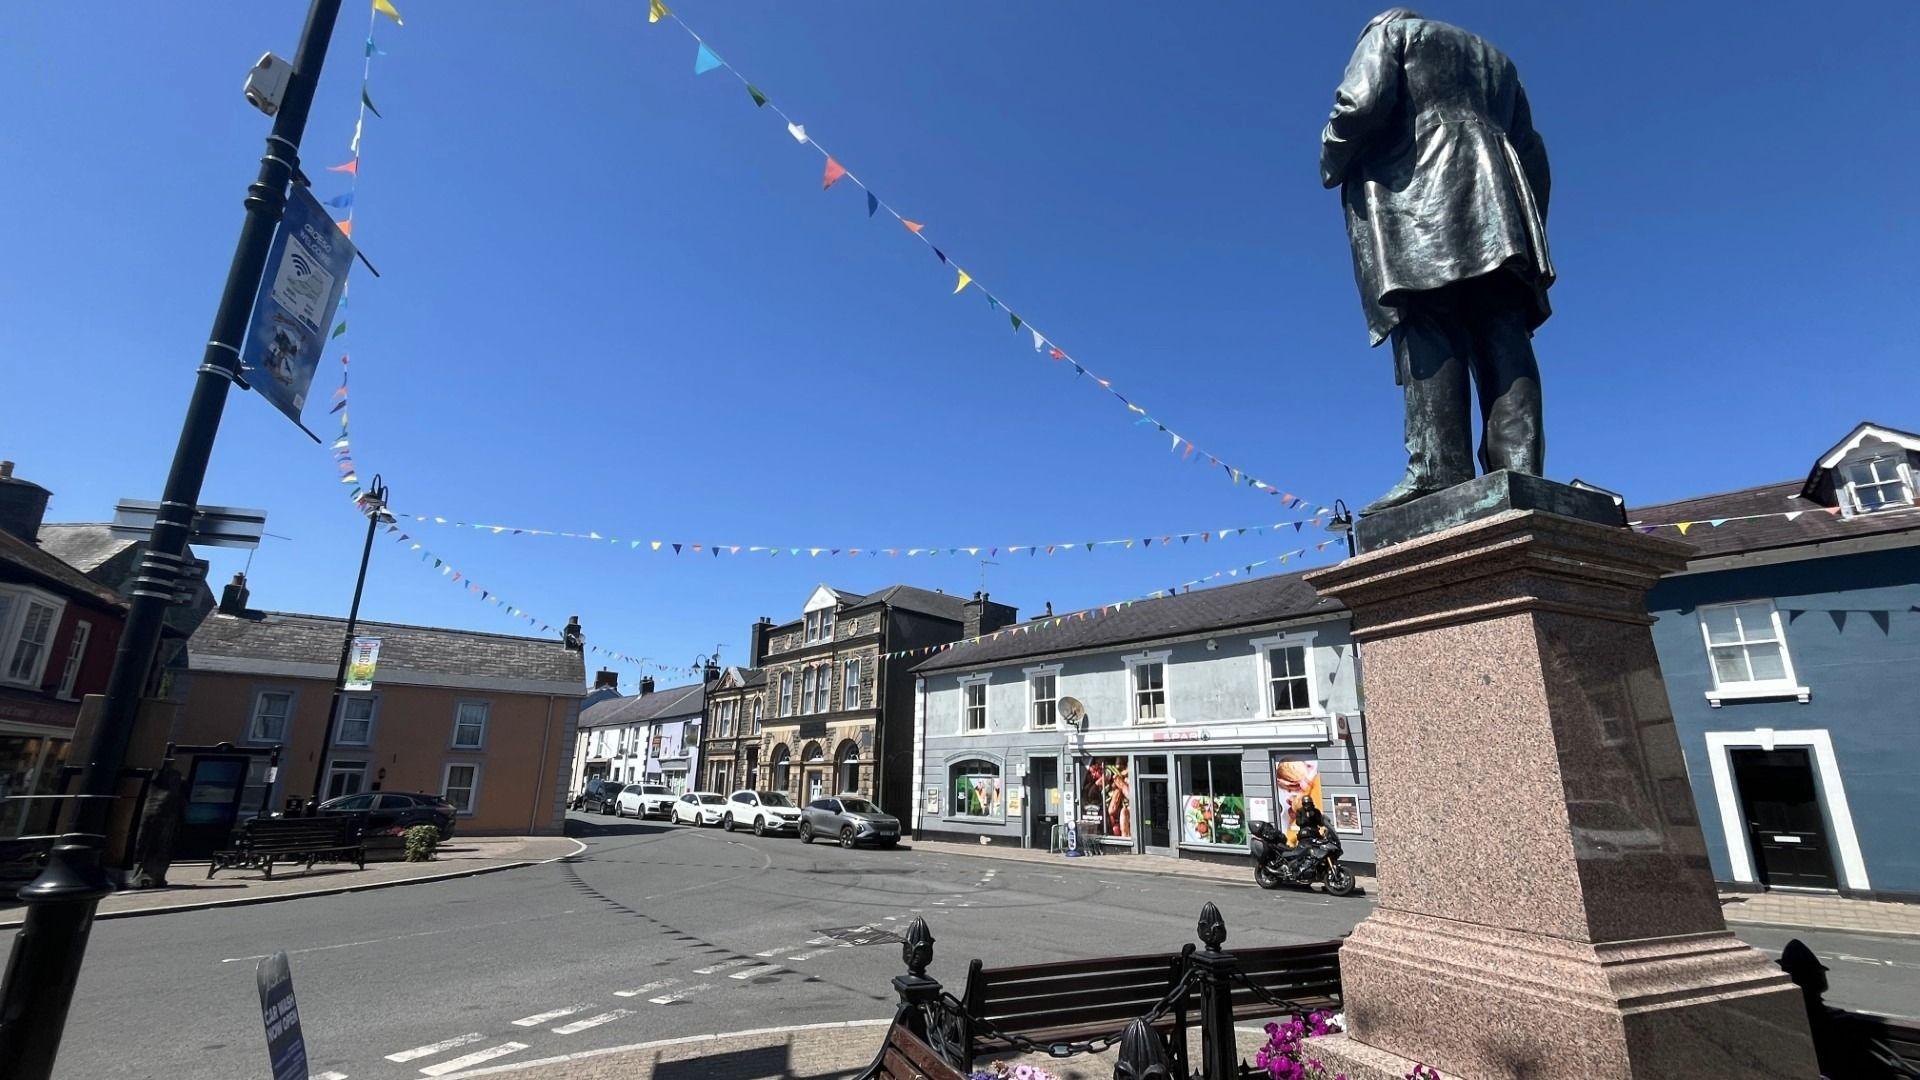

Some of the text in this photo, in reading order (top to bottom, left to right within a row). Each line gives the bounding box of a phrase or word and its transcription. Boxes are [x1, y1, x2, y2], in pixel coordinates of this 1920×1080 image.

[1163, 731, 1198, 741] SPAR
[264, 993, 295, 1026] CAR WASH
[267, 1009, 298, 1043] NOW OPEN
